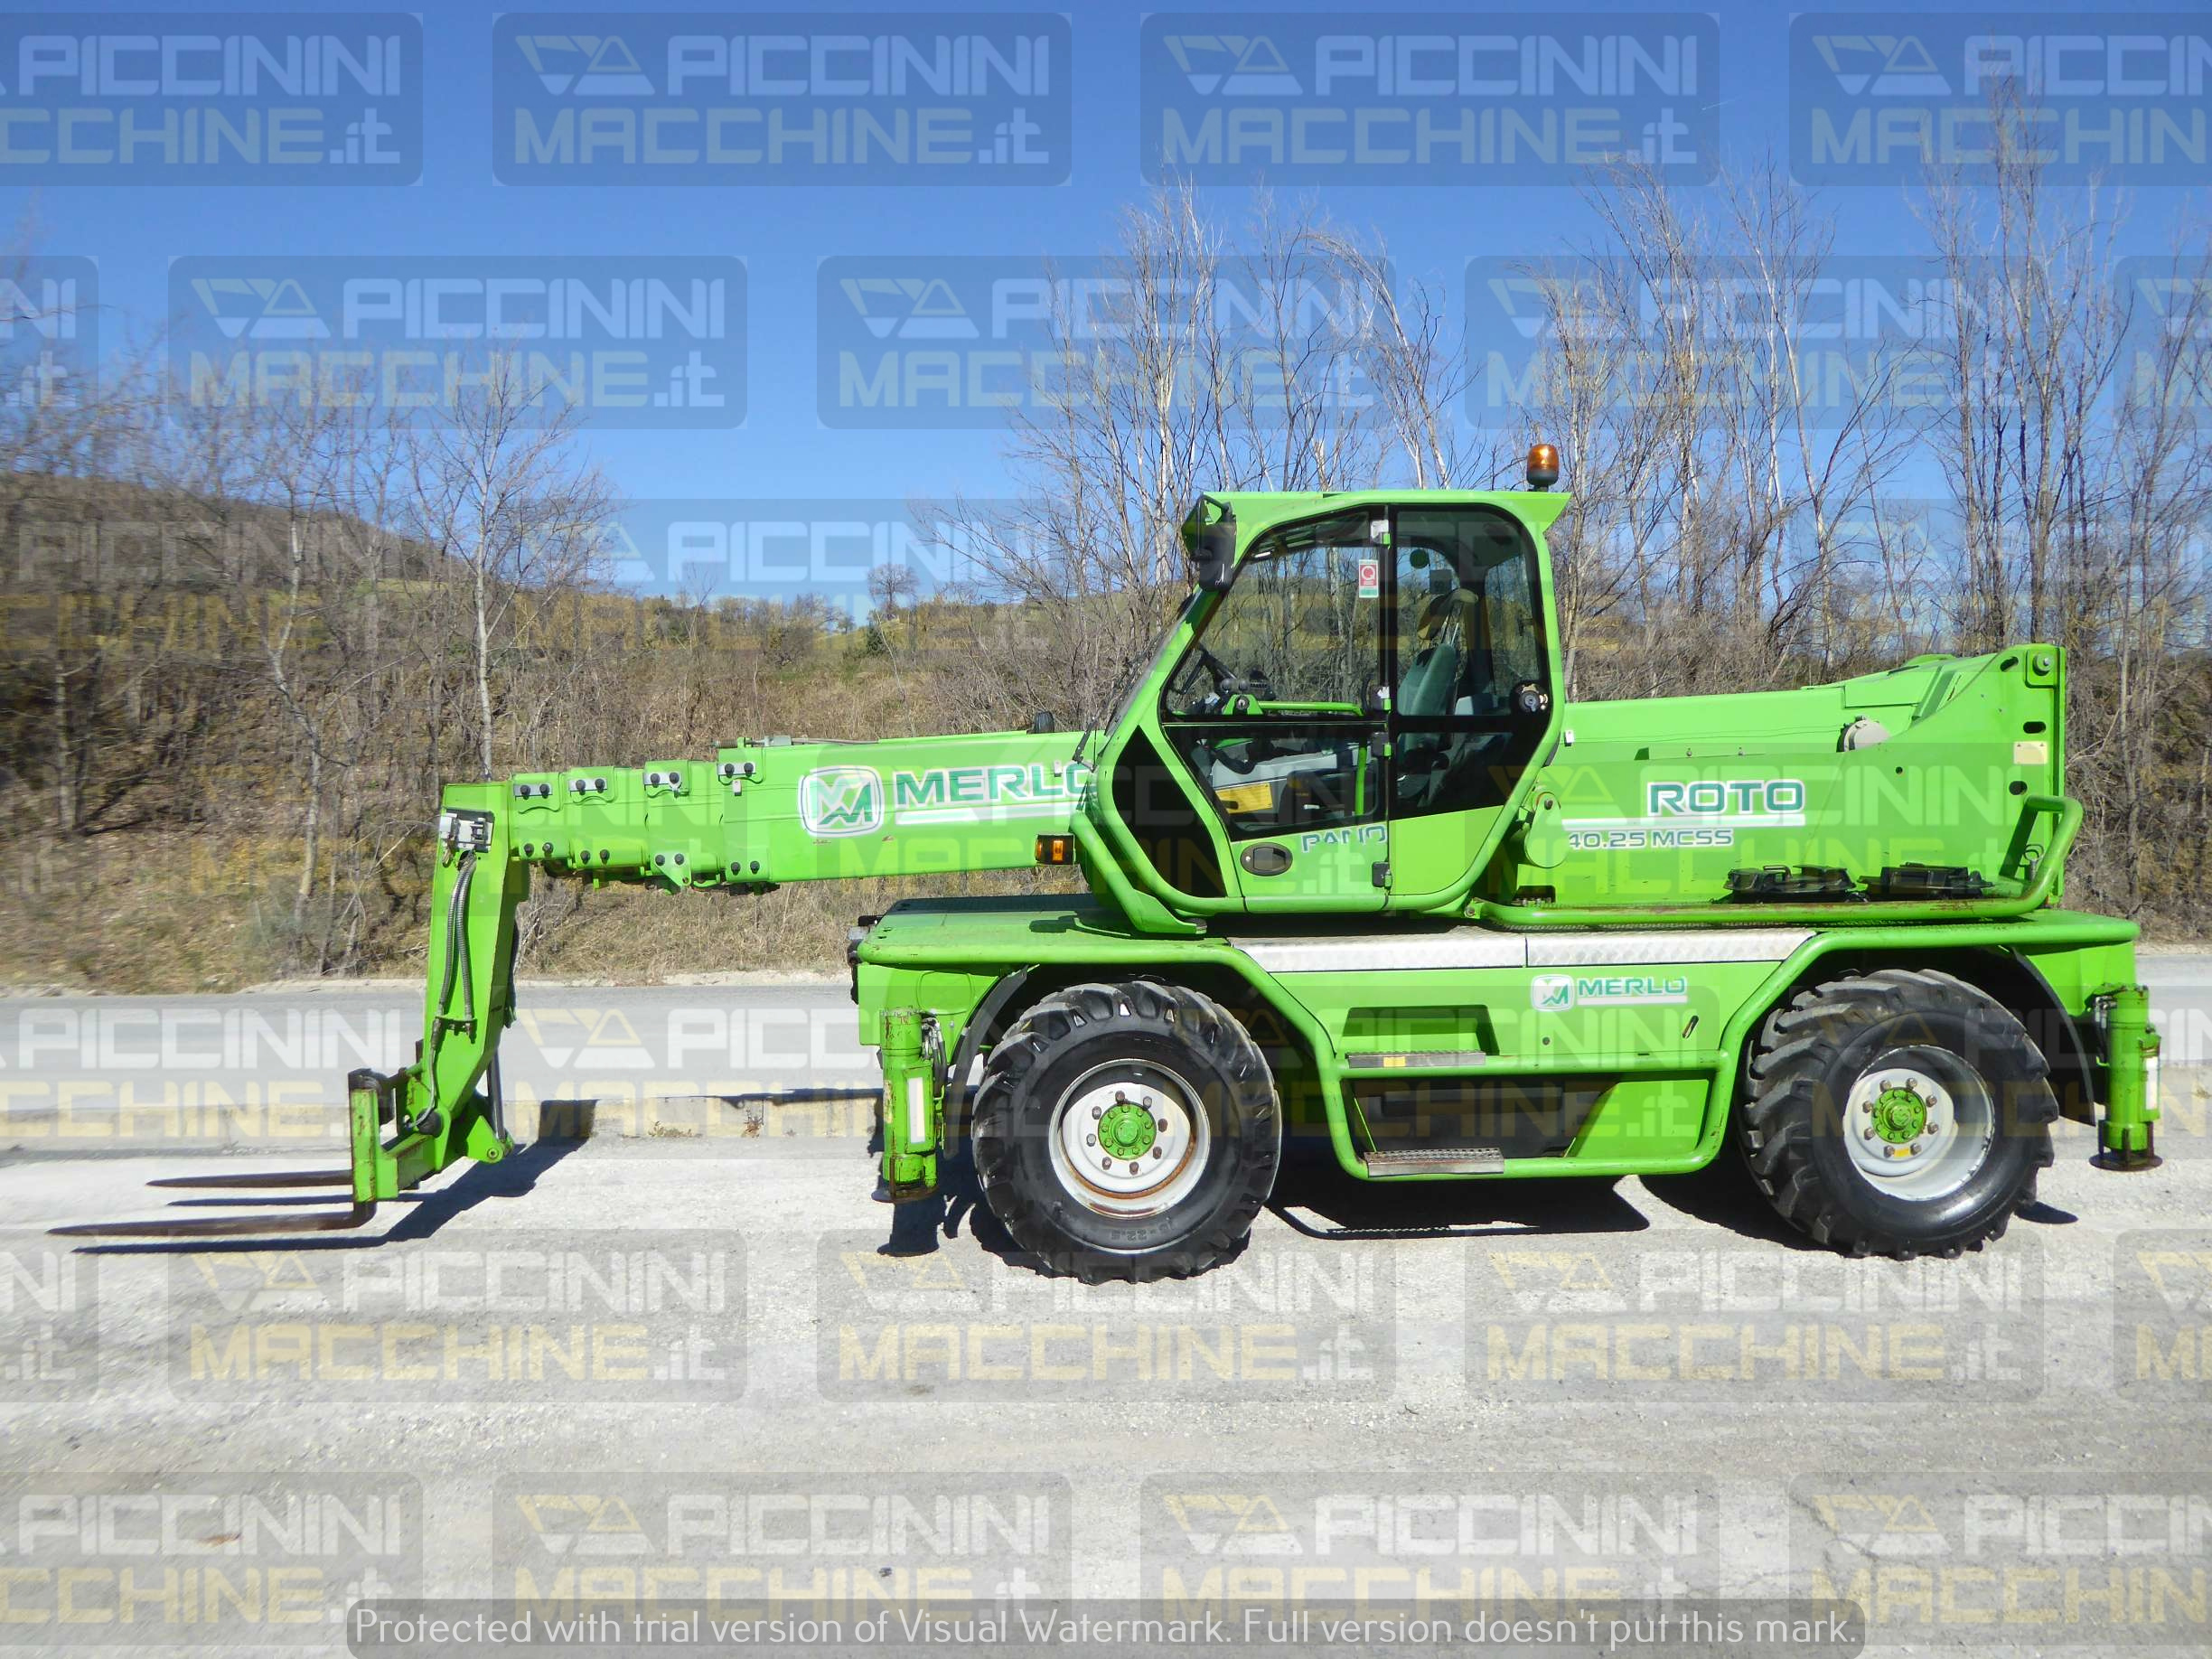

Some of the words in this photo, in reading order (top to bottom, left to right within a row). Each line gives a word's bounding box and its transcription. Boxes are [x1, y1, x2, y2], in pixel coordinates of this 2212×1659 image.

[895, 763, 1097, 806] MERLO
[1648, 780, 1805, 815] ROTO
[1569, 830, 1646, 849] 40.25
[1652, 830, 1733, 848] MCSS
[1577, 977, 1687, 997] MERLO
